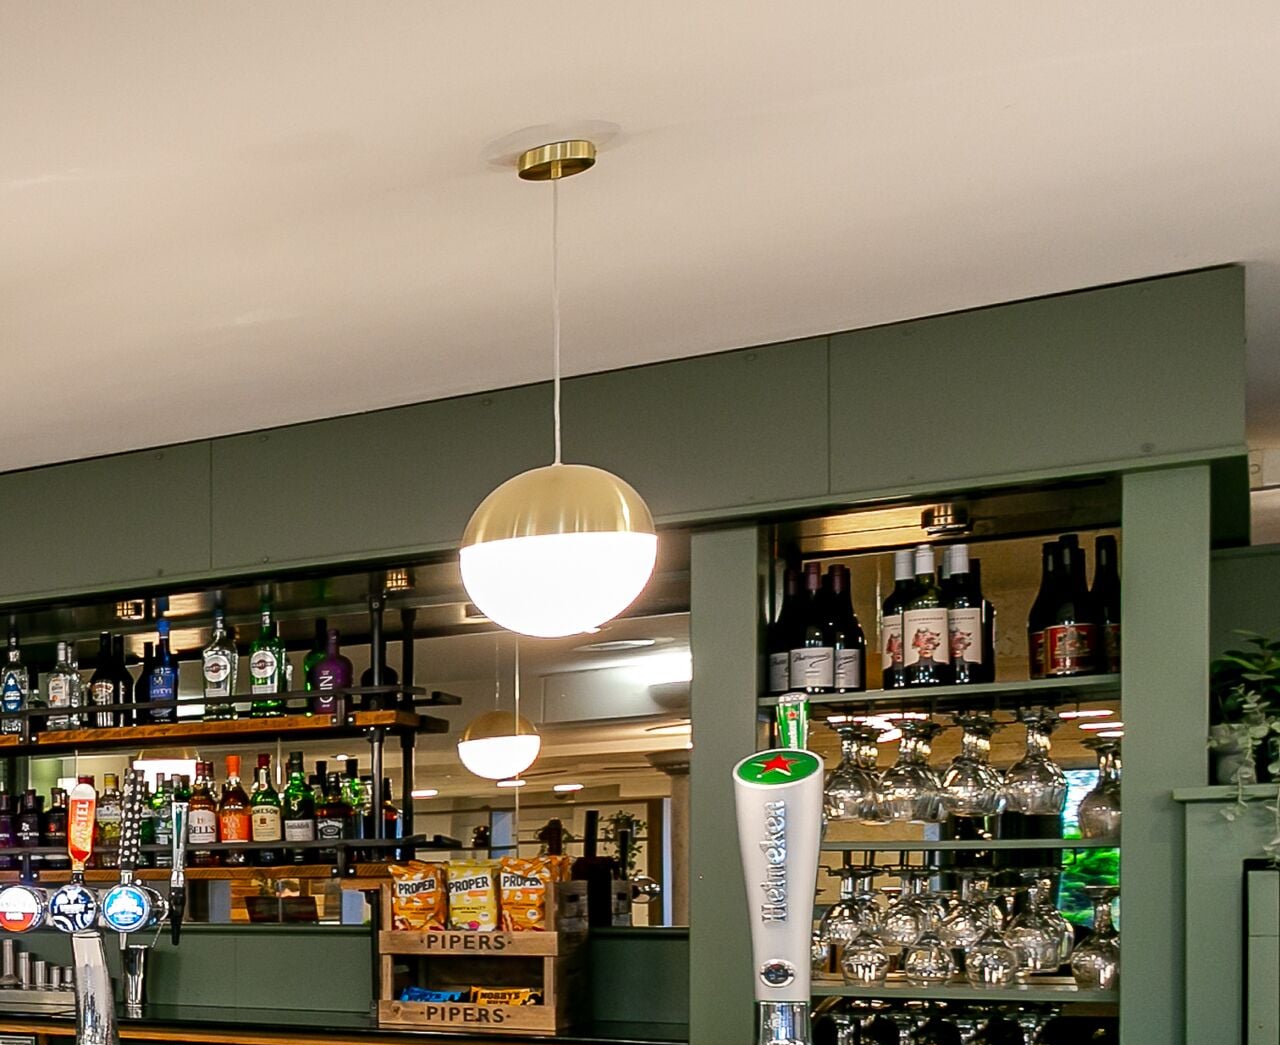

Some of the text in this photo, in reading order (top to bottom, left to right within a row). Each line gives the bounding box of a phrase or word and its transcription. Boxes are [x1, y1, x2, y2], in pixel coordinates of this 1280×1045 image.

[760, 800, 787, 923] Heineken
[398, 878, 435, 895] PROPER
[448, 876, 489, 894] PROPER
[503, 875, 542, 888] PROPER
[427, 934, 506, 950] PIPERS
[426, 1005, 504, 1024] PIPERS
